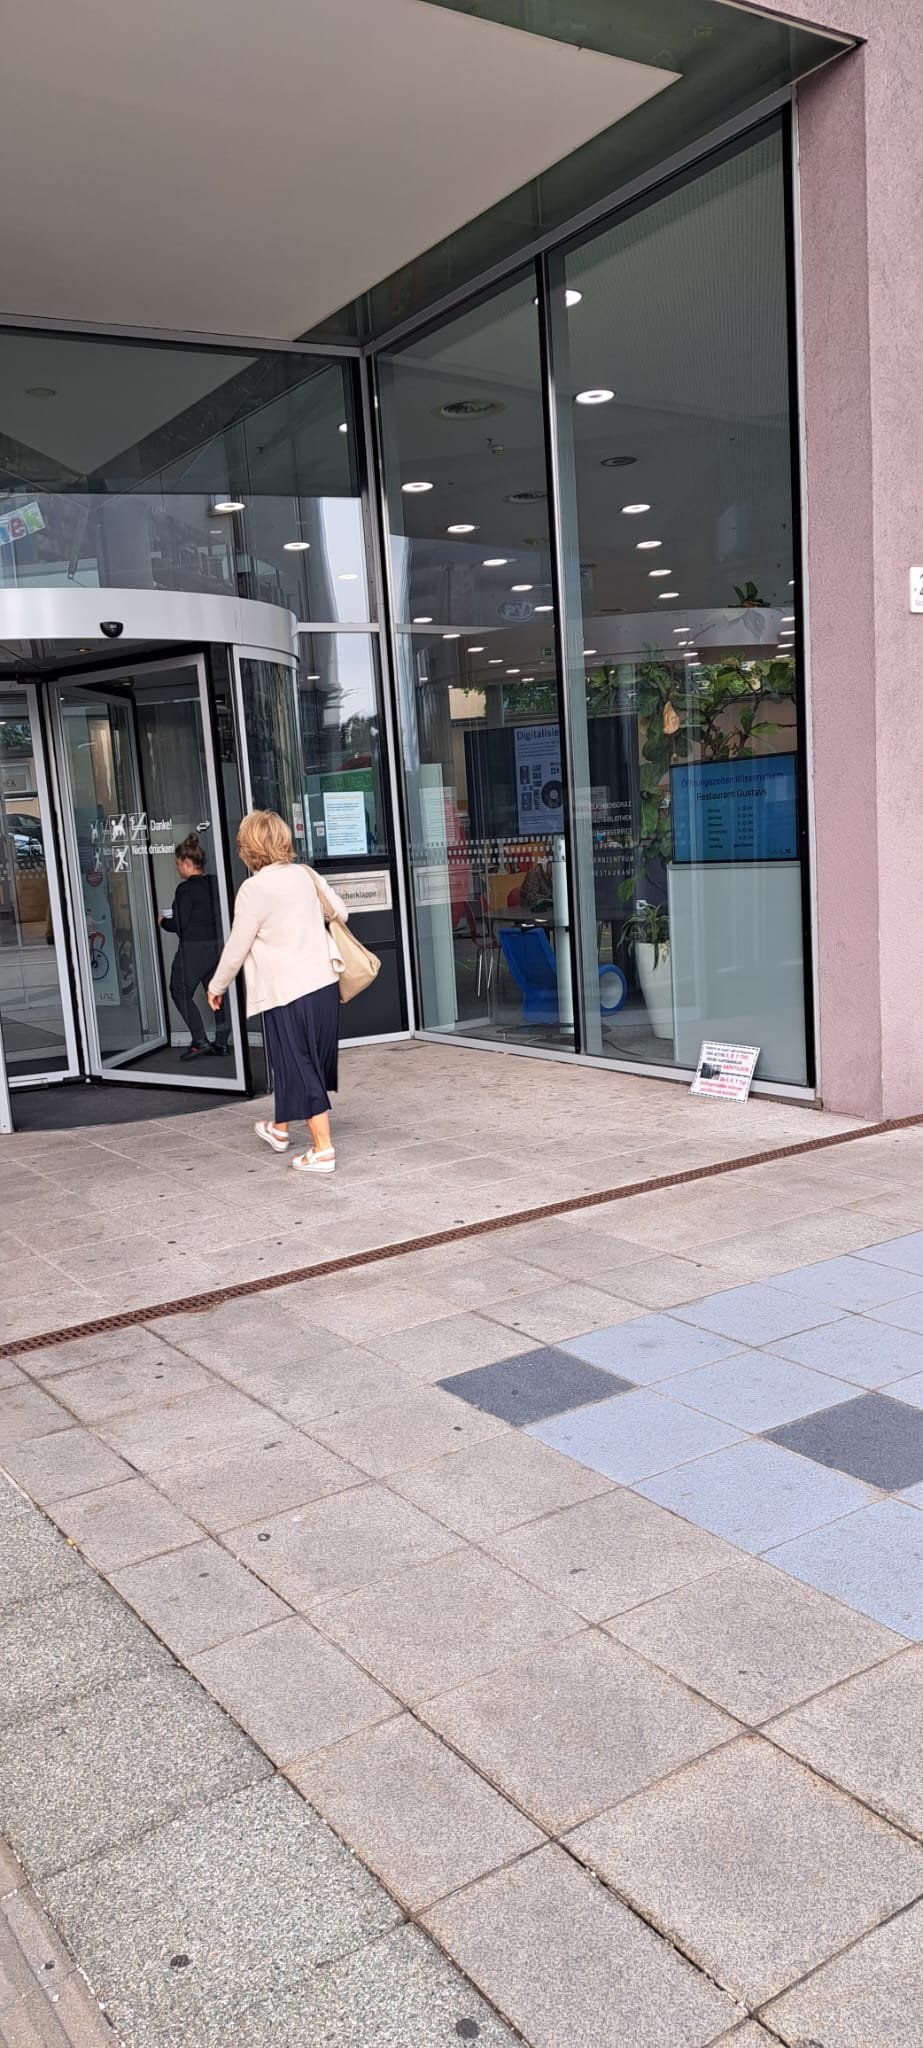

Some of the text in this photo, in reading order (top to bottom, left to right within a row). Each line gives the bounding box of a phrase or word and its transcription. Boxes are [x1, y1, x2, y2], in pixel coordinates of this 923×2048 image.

[150, 818, 173, 831] Danke!
[131, 843, 175, 855] Nicht drücken!
